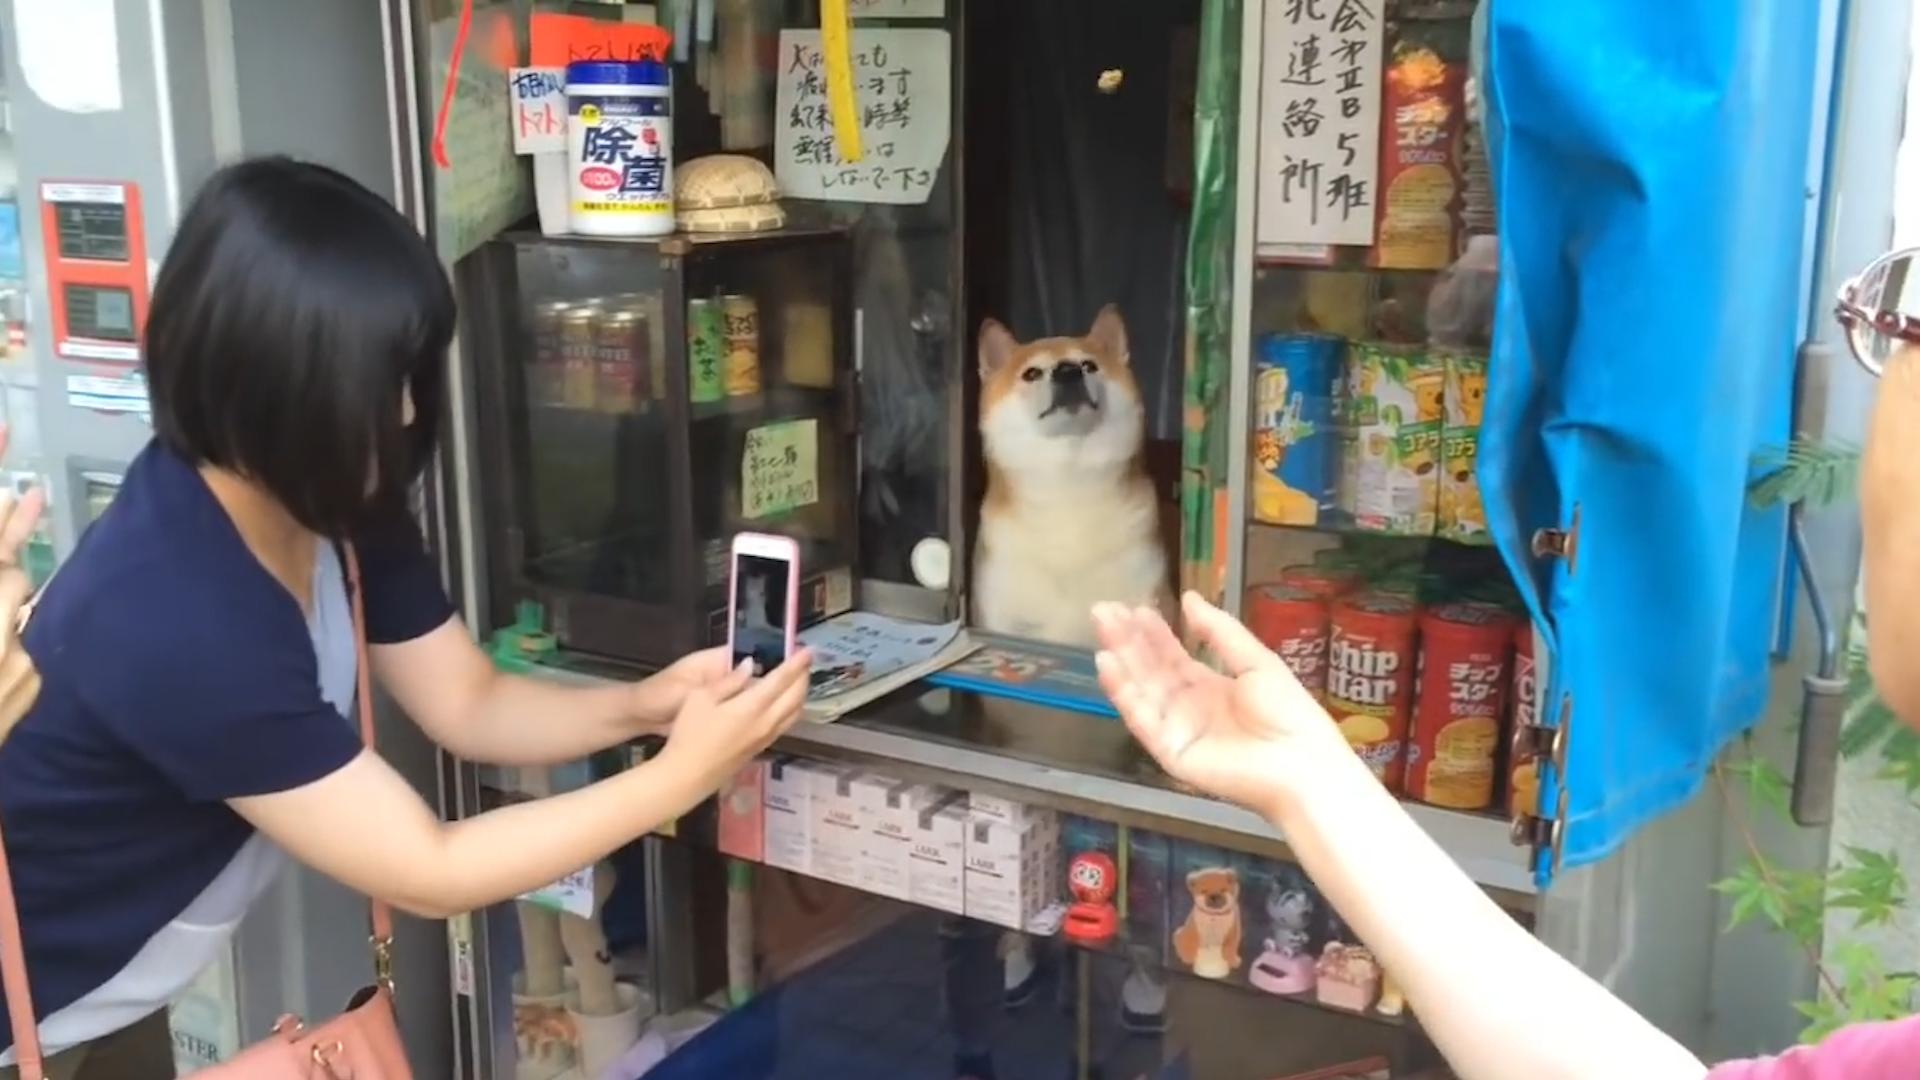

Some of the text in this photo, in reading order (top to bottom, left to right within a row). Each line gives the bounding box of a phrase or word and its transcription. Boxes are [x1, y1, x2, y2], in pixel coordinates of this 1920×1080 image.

[582, 126, 667, 193] 除菌
[1449, 662, 1502, 681] チップ
[1448, 681, 1498, 701] スター
